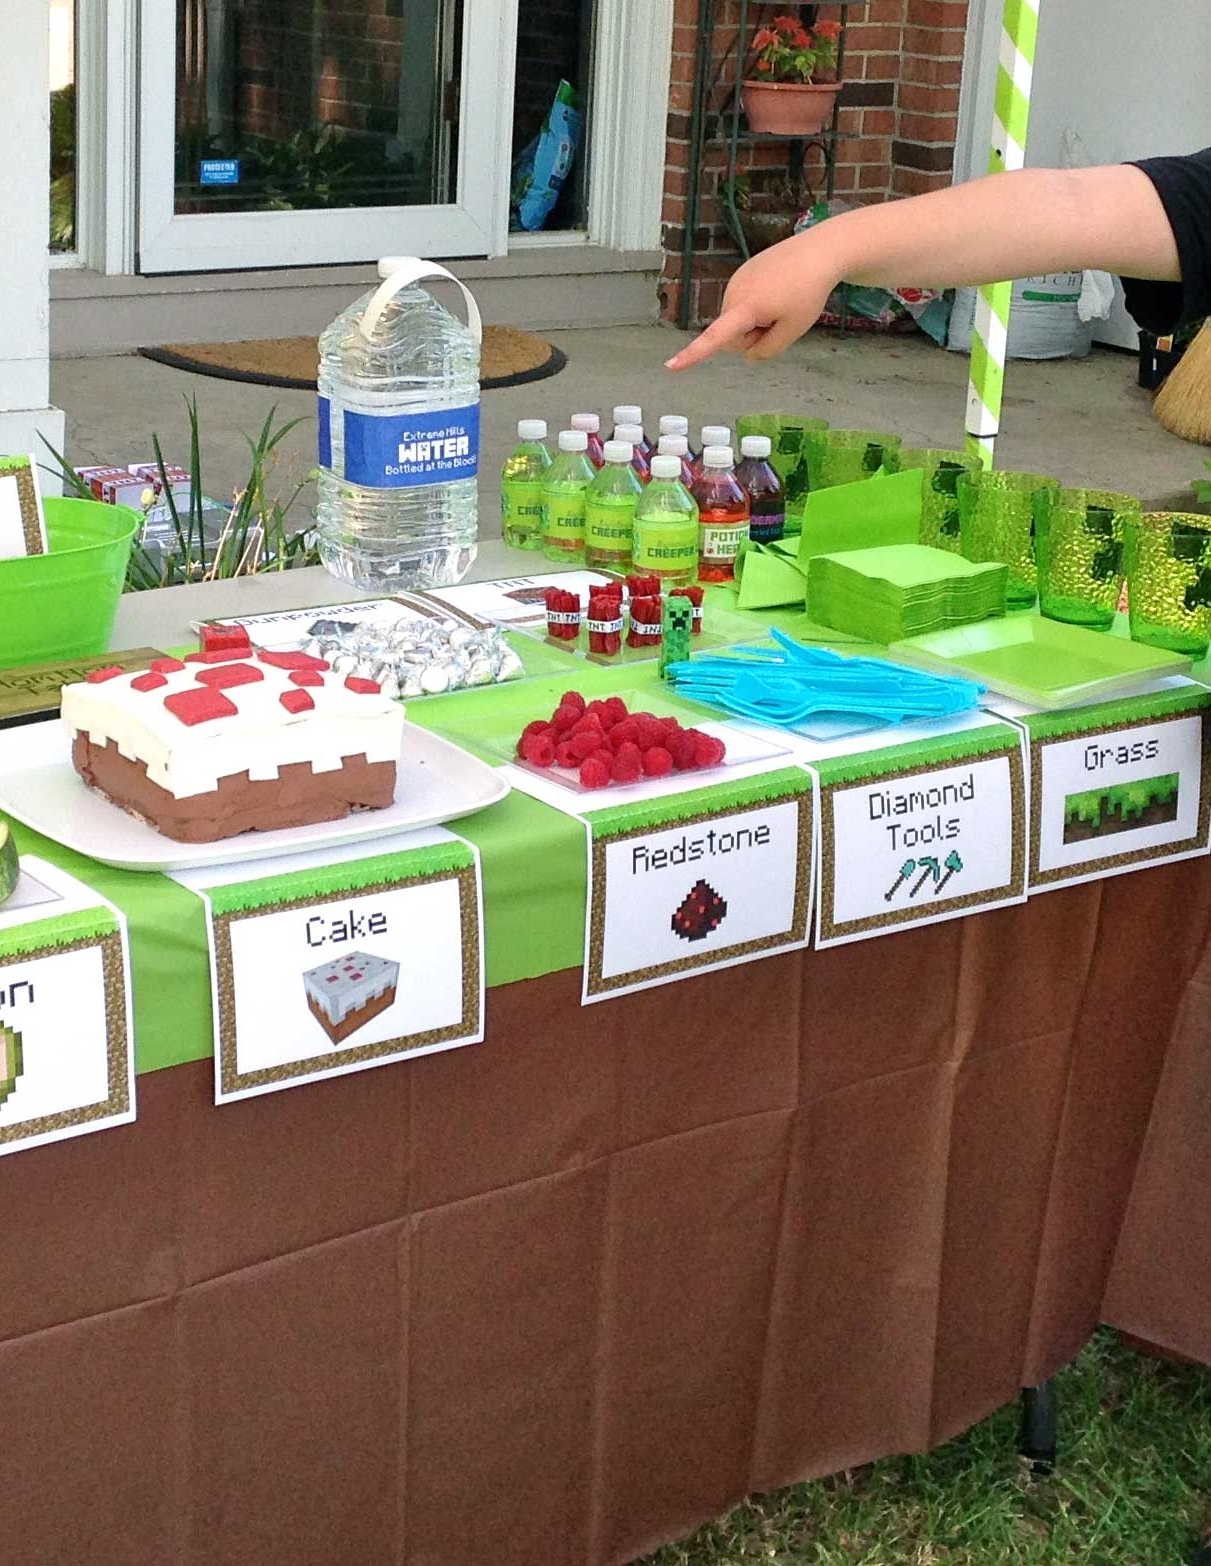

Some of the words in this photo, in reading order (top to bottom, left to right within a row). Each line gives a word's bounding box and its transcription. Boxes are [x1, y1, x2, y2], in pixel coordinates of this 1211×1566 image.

[398, 435, 469, 464] WATER
[385, 463, 424, 476] Bottled
[485, 578, 535, 589] TNT
[588, 621, 606, 631] TNT
[1084, 737, 1160, 771] Grass
[868, 774, 975, 822] Diamond
[631, 820, 771, 874] Redstone
[886, 814, 961, 851] Tools
[305, 909, 388, 947] Cake
